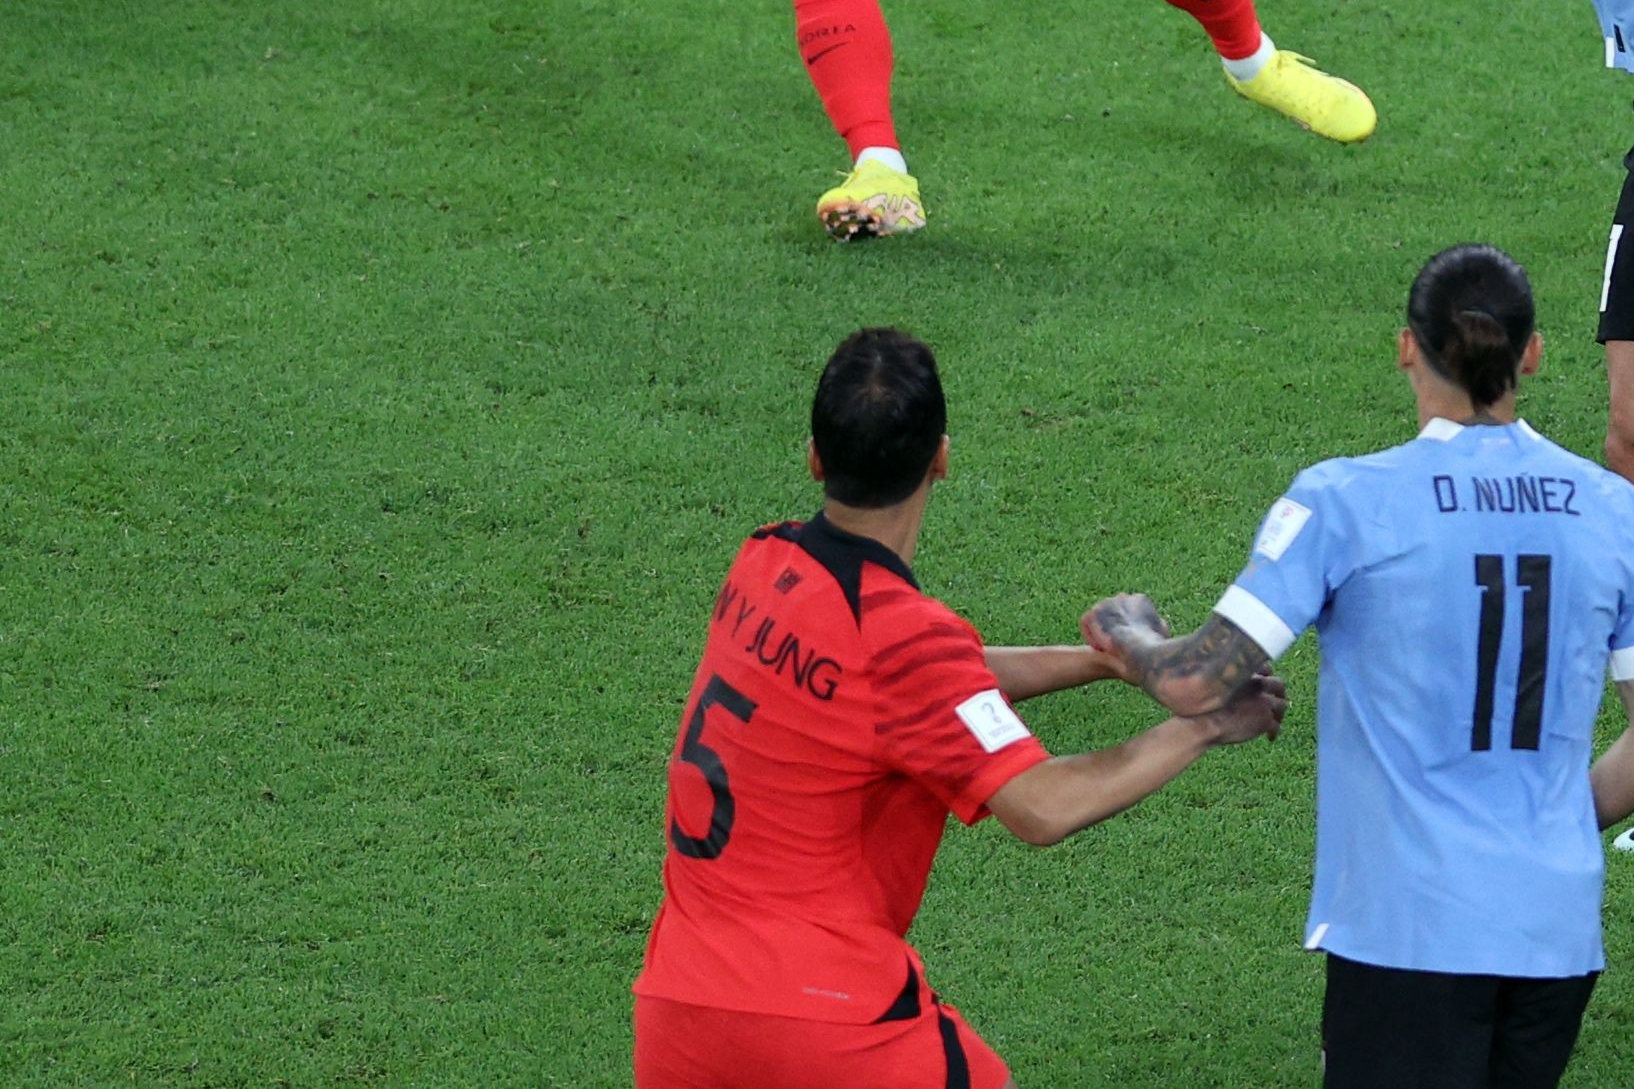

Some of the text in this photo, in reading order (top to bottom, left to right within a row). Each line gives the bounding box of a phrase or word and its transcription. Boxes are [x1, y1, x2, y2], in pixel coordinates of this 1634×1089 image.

[1433, 473, 1468, 513] D.
[745, 615, 843, 701] JUNG
[1470, 553, 1552, 751] 11
[670, 672, 761, 860] 5
